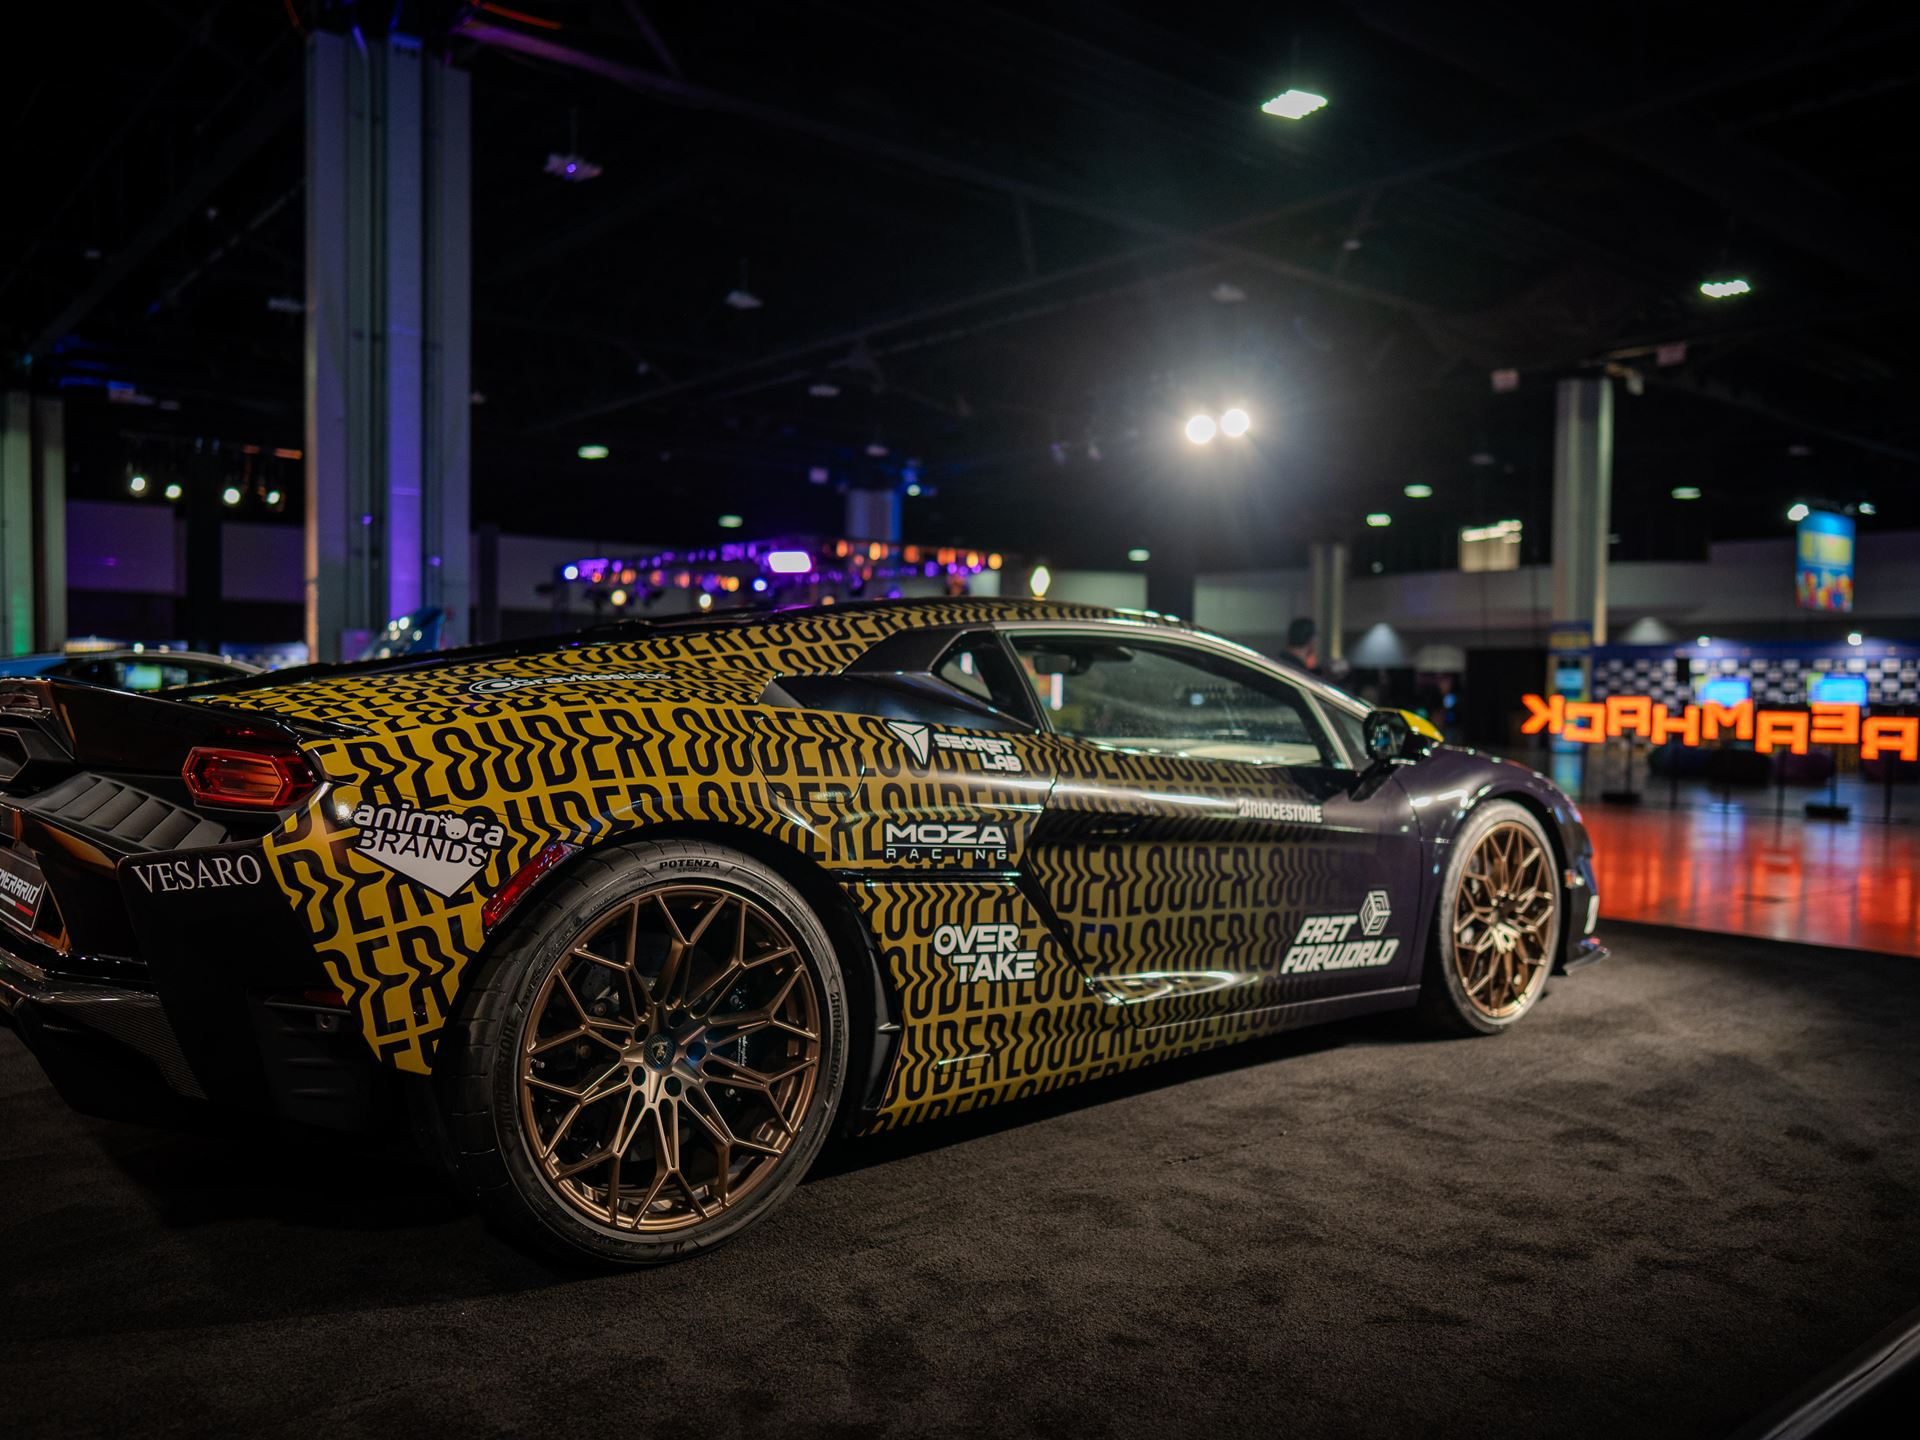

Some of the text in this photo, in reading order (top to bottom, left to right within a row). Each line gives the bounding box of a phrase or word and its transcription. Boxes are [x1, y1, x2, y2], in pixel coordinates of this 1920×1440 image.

[933, 733, 1014, 755] SECRET
[981, 752, 1022, 773] LAB
[353, 803, 504, 847] animoca
[1238, 798, 1323, 823] BRIDGESTONE
[358, 827, 489, 867] BRANDS
[886, 823, 1007, 845] MOZA
[659, 858, 721, 870] POTENZA
[886, 848, 1007, 861] RACING
[131, 854, 262, 893] VESARO
[934, 923, 1020, 956] OVER
[1294, 915, 1359, 945] FAST
[952, 951, 1038, 983] TAKE
[1281, 938, 1400, 975] FORWORLD
